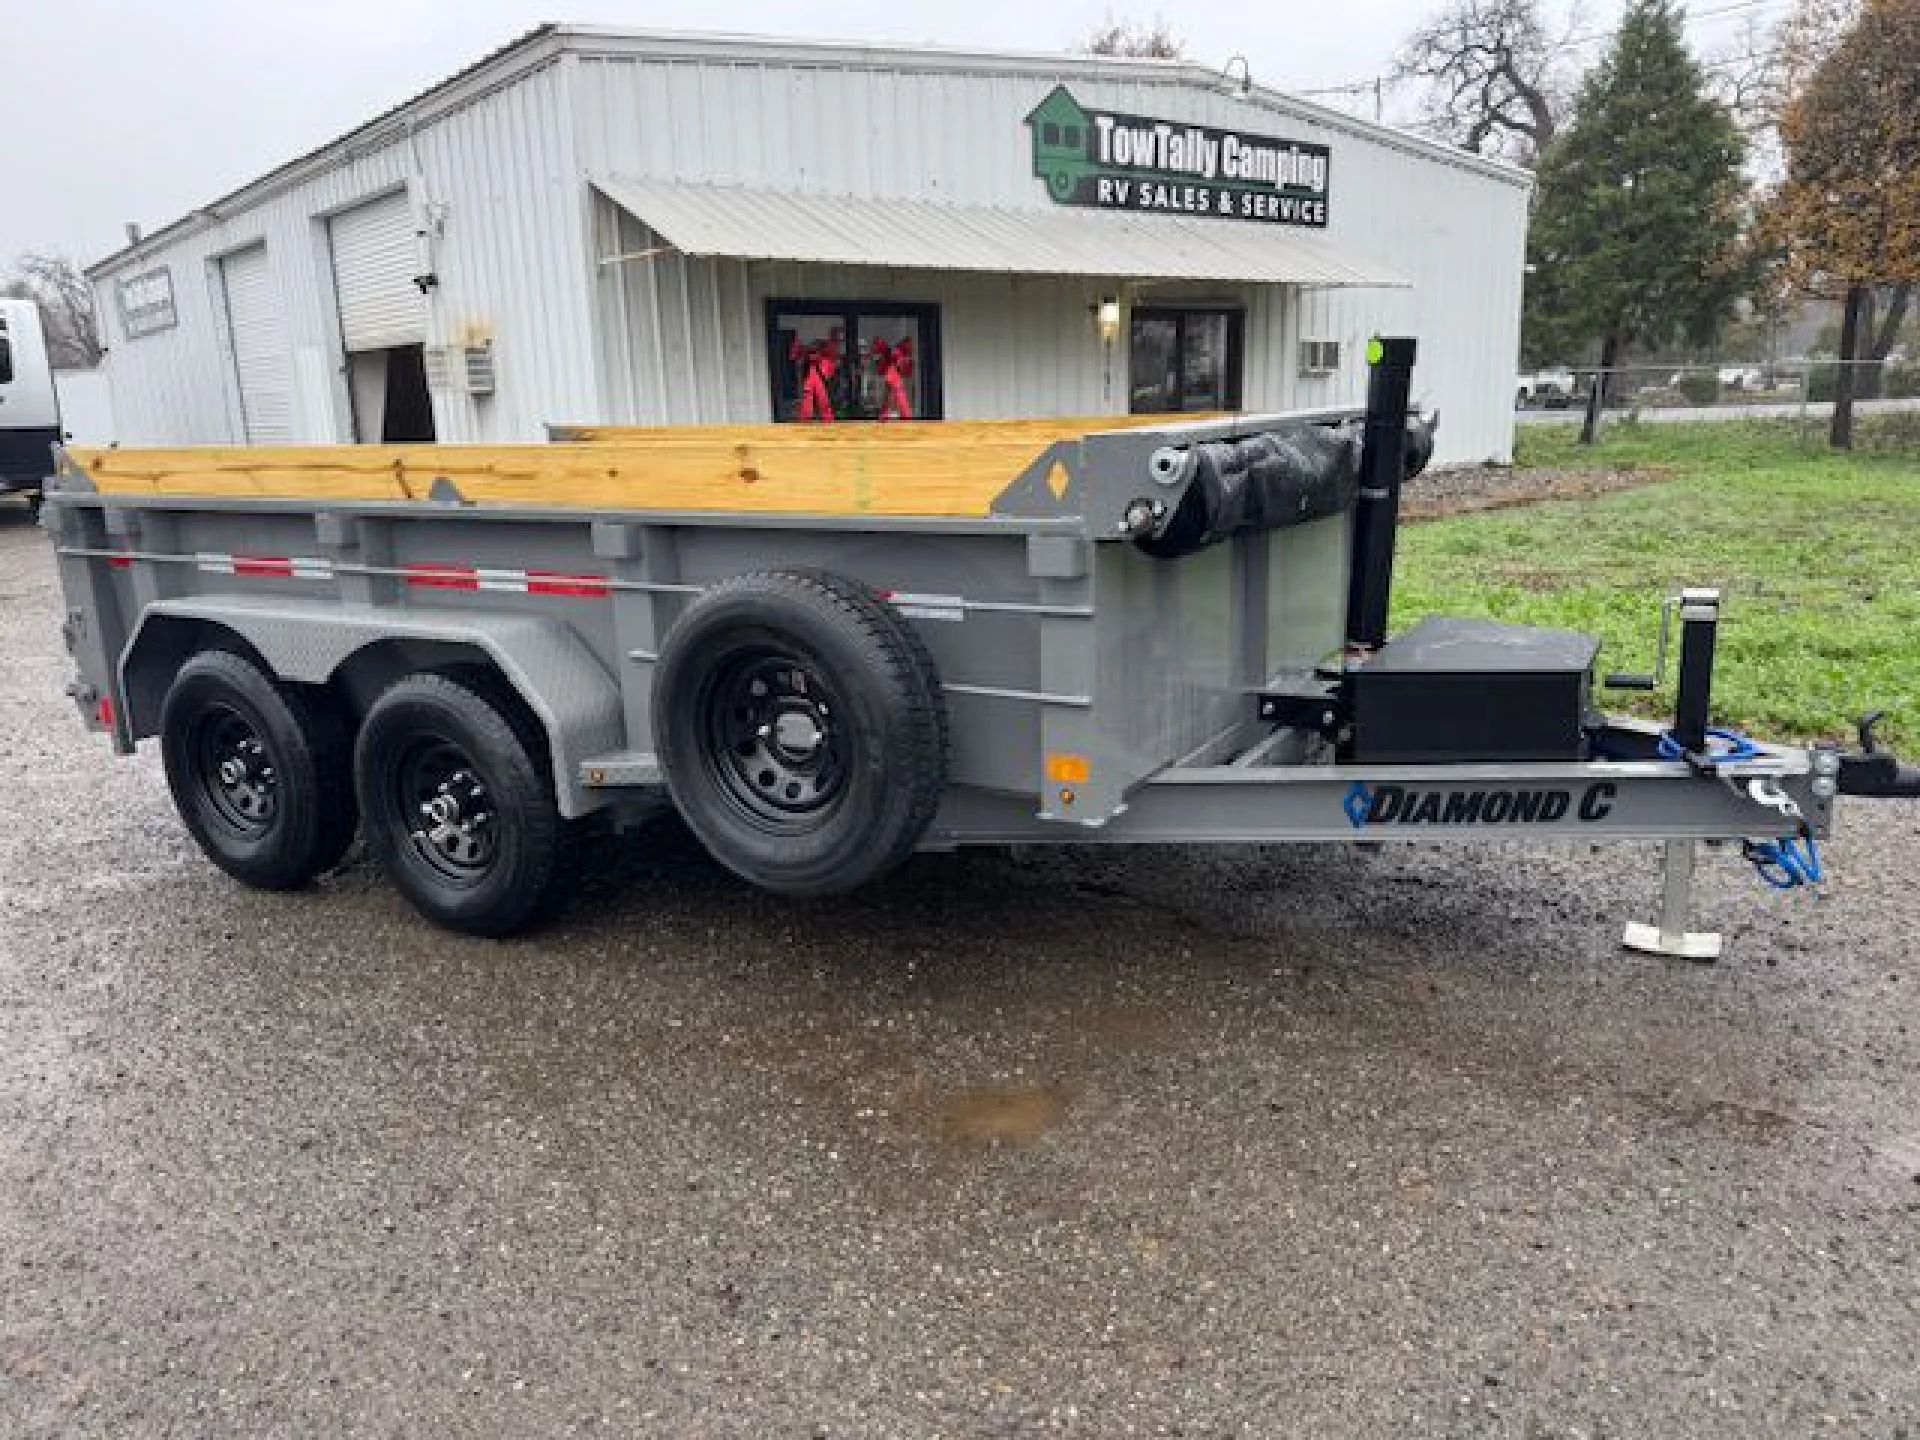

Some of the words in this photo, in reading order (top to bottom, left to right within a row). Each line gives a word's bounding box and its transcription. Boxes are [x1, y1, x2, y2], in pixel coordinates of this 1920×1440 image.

[1095, 116, 1219, 178] TowTally
[1223, 135, 1327, 192] Camping
[1098, 179, 1129, 204] RV
[1140, 182, 1210, 211] SALES
[1220, 191, 1233, 214] &
[1241, 194, 1325, 223] SERVICE
[1366, 785, 1570, 823] DIAMOND
[1578, 782, 1617, 822] C
